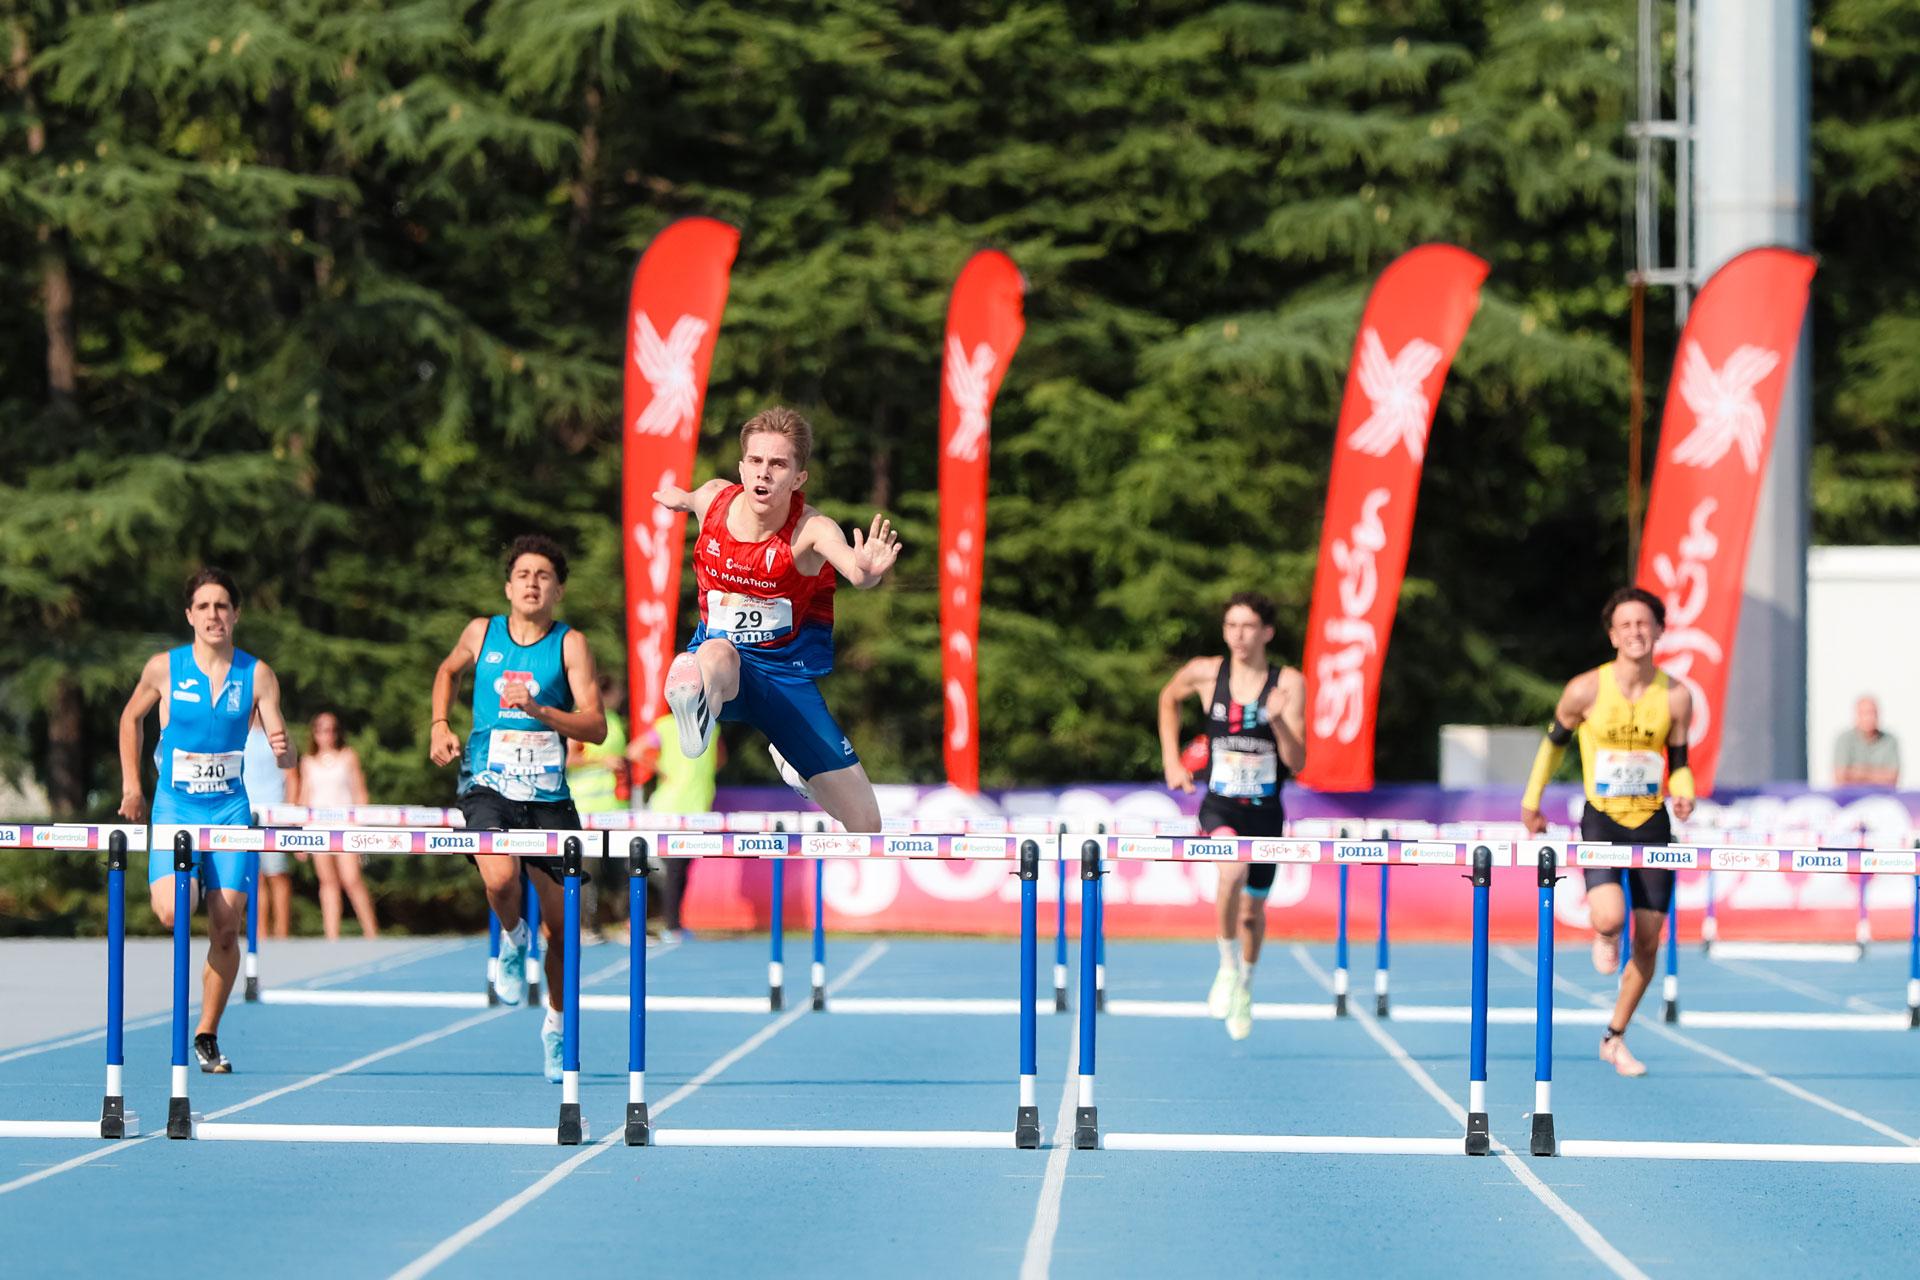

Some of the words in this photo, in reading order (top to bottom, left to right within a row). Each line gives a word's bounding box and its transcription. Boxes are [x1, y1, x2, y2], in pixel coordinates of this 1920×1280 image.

[721, 572, 777, 589] MARATHON
[735, 610, 763, 630] 29
[515, 748, 534, 763] 11
[192, 763, 226, 779] 340
[1612, 767, 1646, 784] 459
